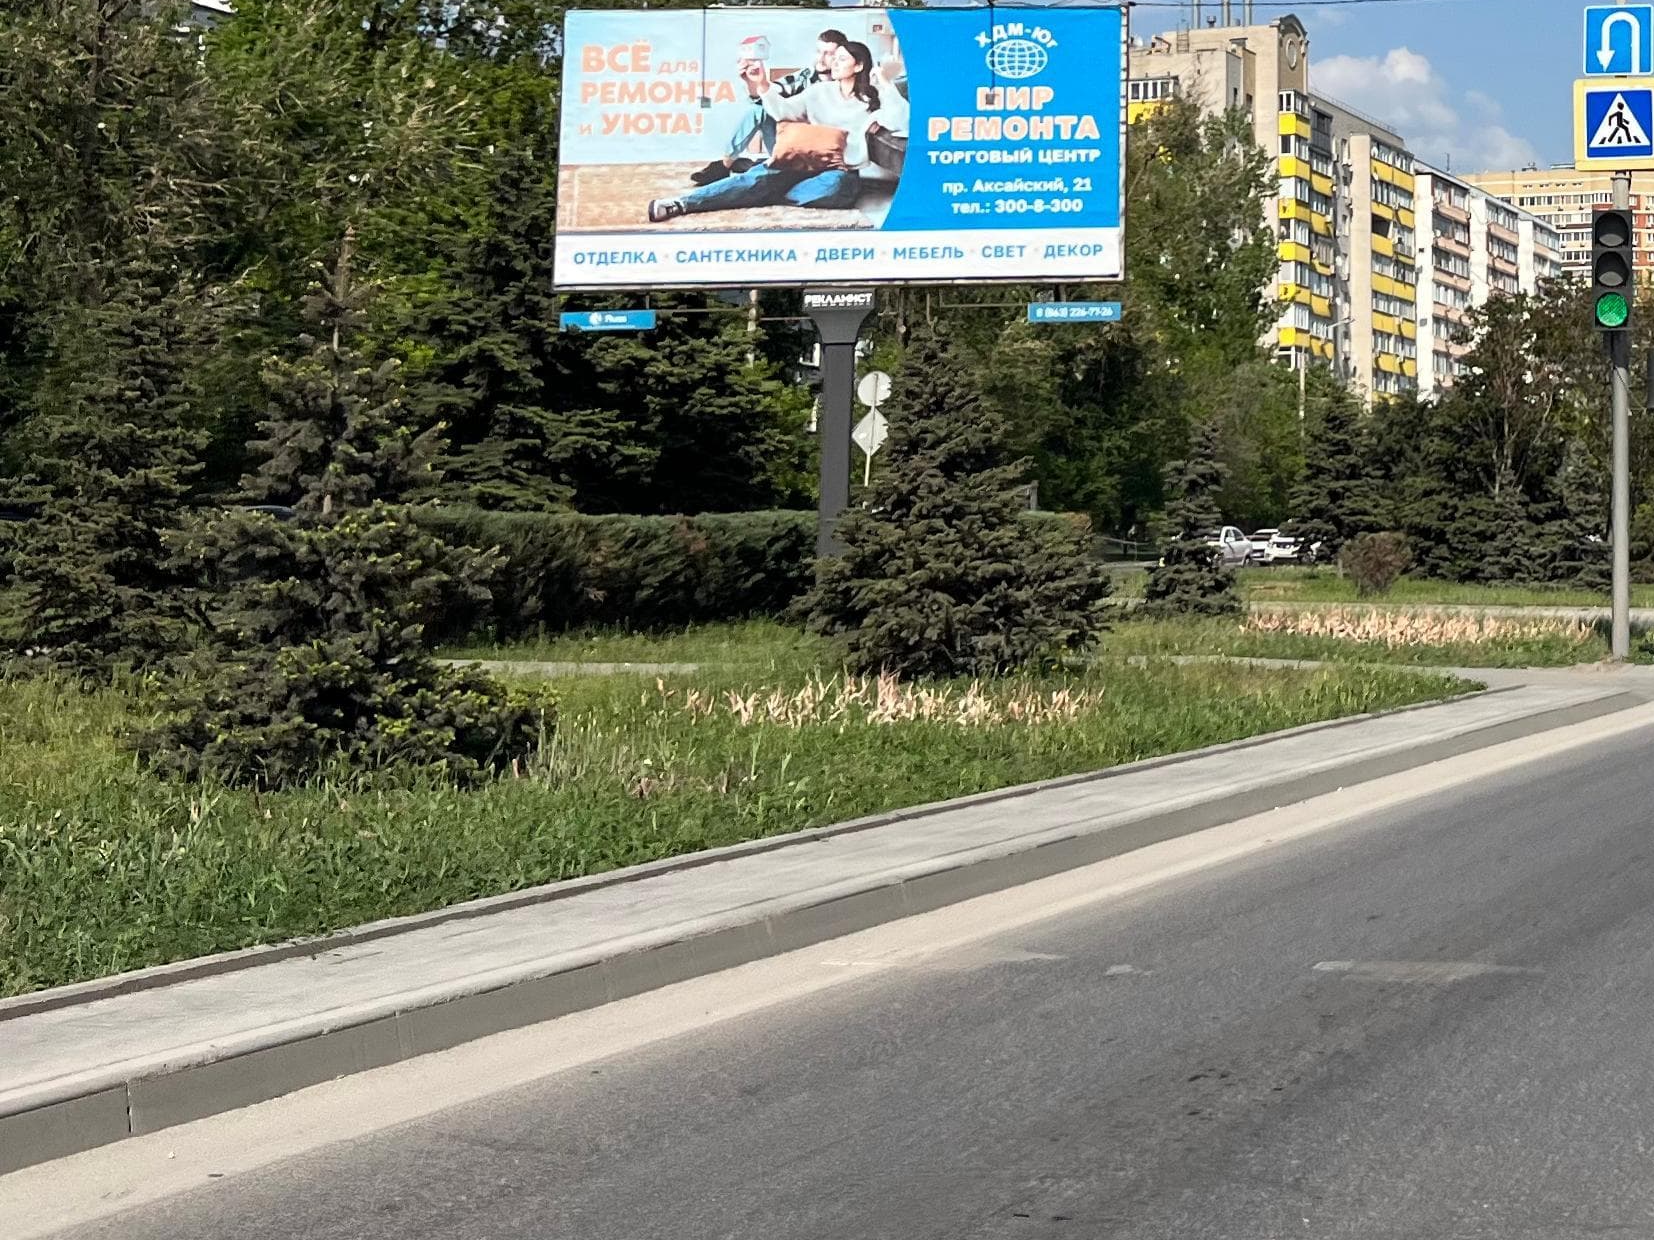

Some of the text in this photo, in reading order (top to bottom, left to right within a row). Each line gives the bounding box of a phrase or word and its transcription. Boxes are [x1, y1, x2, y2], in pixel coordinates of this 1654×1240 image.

[582, 39, 699, 74] ВСЁ для
[581, 81, 737, 104] РЕМОНТА
[976, 86, 1054, 111] МИР
[578, 113, 704, 136] и УЮТА!
[928, 115, 1100, 141] РЕМОНТА
[928, 148, 1101, 164] ТОРГОВЫЙ ЦЕНТР
[942, 177, 1092, 195] пр. Аксайский, 21
[952, 198, 1084, 214] тел.: 300-8-300
[574, 244, 1104, 265] ОТДЕЛКА САНТЕХНИКА ДВЕРИ МЕБЕЛЬ СВЕТ ДЕКОР
